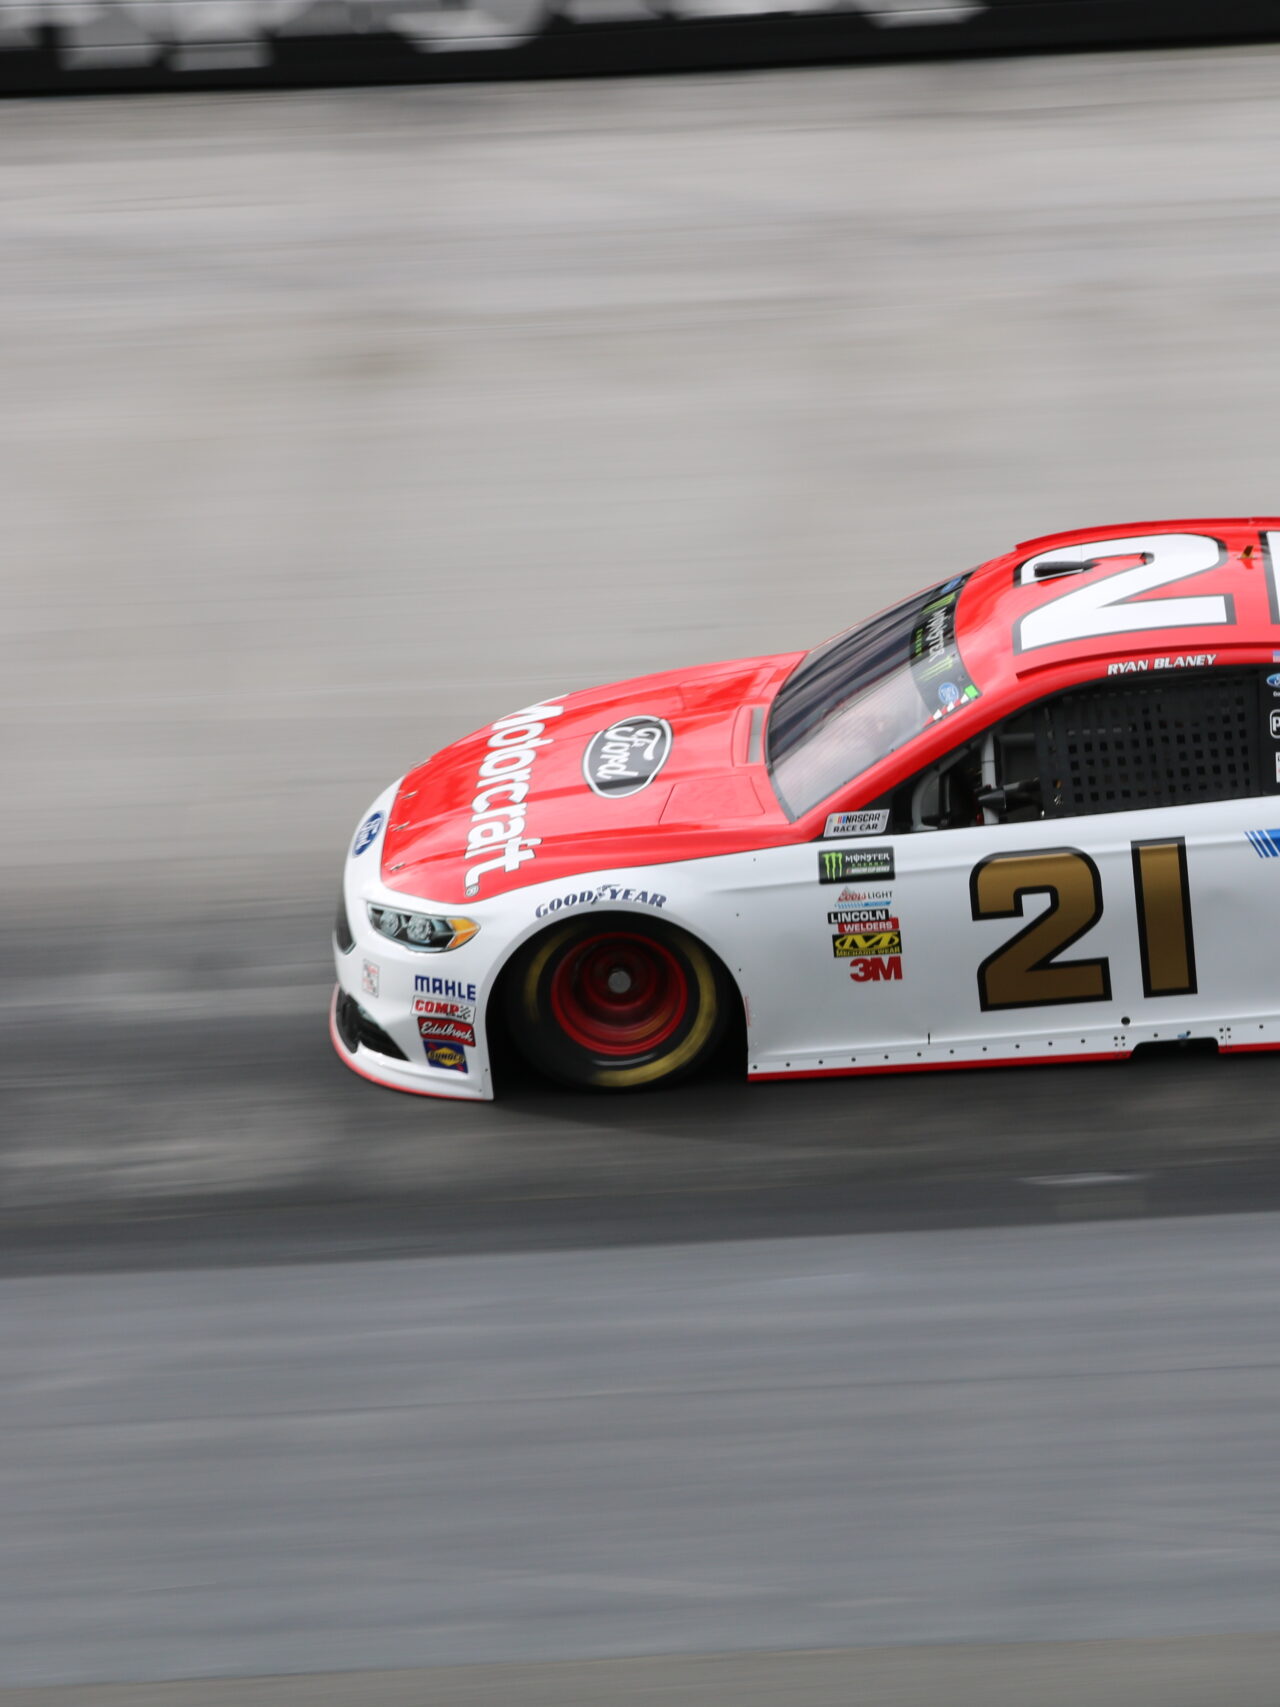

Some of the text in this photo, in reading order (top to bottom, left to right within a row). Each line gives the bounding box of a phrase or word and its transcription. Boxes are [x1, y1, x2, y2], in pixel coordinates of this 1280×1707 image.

[1107, 653, 1217, 676] RYAN BLANEY
[596, 726, 663, 780] Ford
[832, 823, 879, 833] RACE CAR
[845, 812, 882, 824] NASCAR
[845, 852, 891, 864] MONSTER
[534, 885, 668, 919] GOODYEAR
[867, 890, 893, 900] LIGHT
[830, 909, 887, 924] LINCOLN
[843, 920, 893, 932] WELDERS
[968, 835, 1199, 1013] 21
[849, 955, 903, 983] 3M
[414, 973, 477, 1001] MAHLE
[414, 998, 460, 1015] COMP
[420, 1020, 474, 1043] Edelbrock
